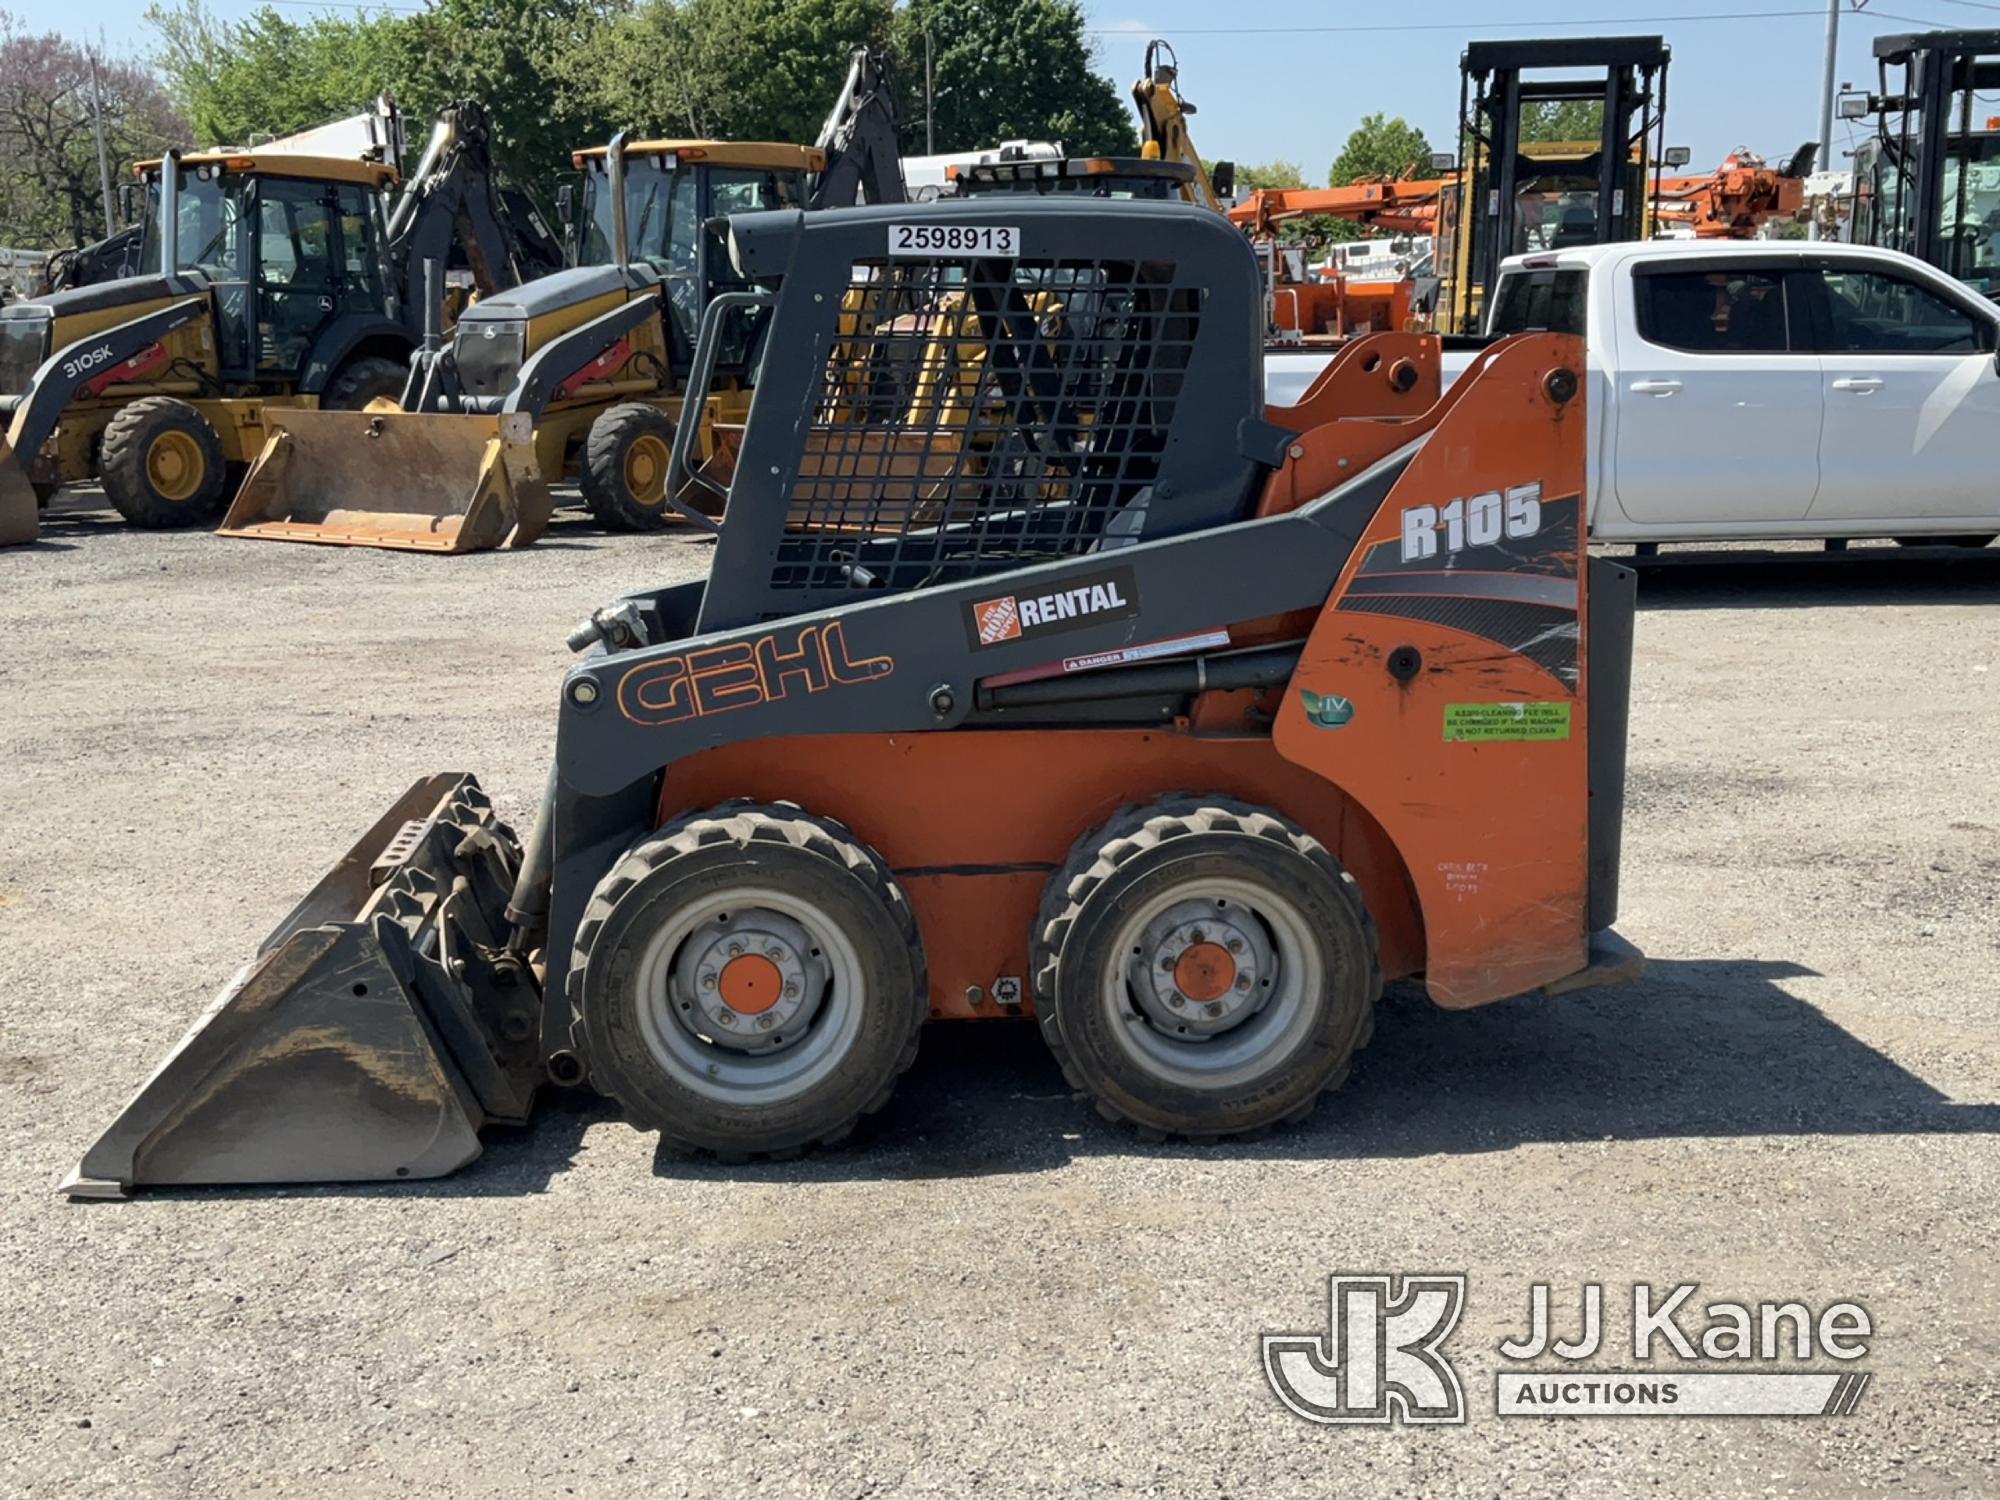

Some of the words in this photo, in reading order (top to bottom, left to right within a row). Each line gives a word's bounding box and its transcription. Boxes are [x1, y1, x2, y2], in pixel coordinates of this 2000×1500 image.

[898, 227, 1011, 250] 2598913
[63, 344, 114, 379] 310SK
[1402, 481, 1543, 563] R105
[981, 598, 1013, 642] HOME
[1018, 582, 1127, 627] RENTAL
[617, 621, 894, 725] GEHL
[1079, 653, 1120, 666] DANGER
[1326, 697, 1347, 711] IV
